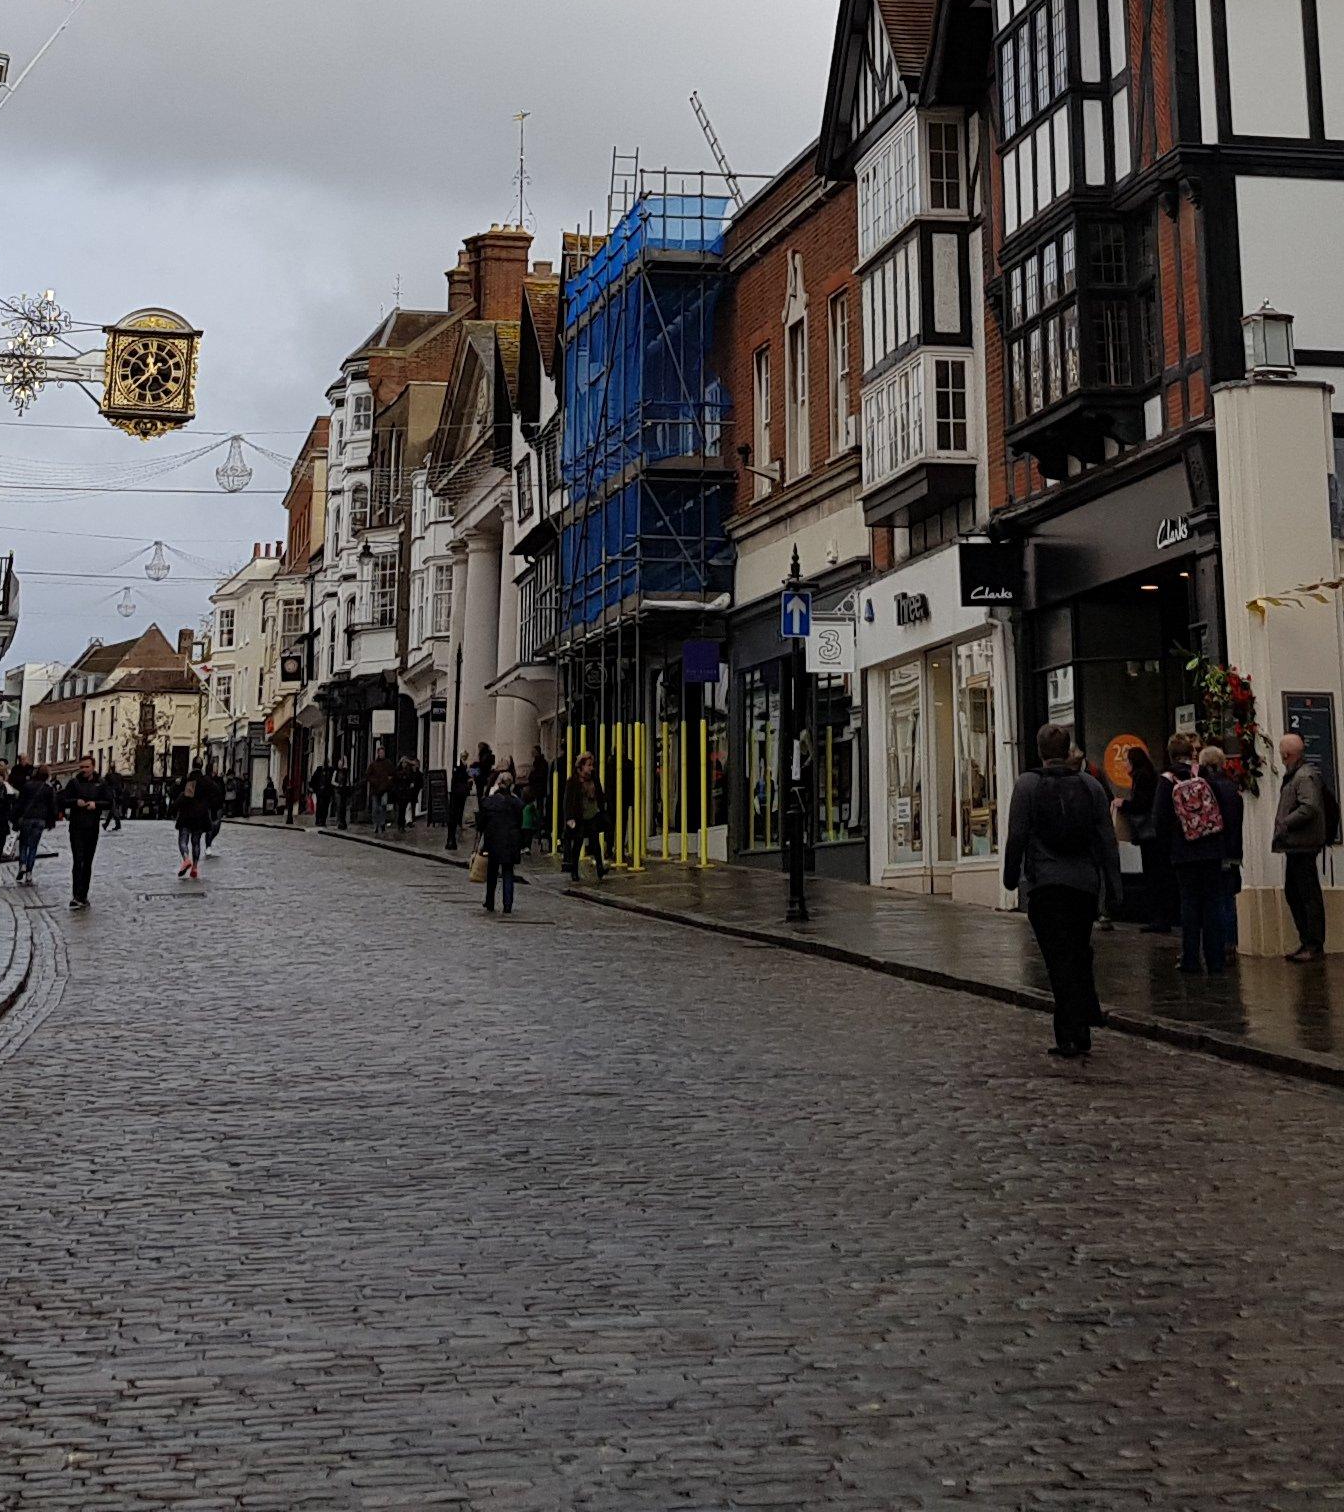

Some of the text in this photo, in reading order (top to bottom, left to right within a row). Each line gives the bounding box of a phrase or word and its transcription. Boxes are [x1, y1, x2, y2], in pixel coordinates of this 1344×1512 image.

[1156, 515, 1189, 550] Clarks
[894, 592, 930, 626] Three
[970, 586, 1014, 600] Clarks
[818, 629, 842, 661] 3
[1290, 714, 1300, 728] 2
